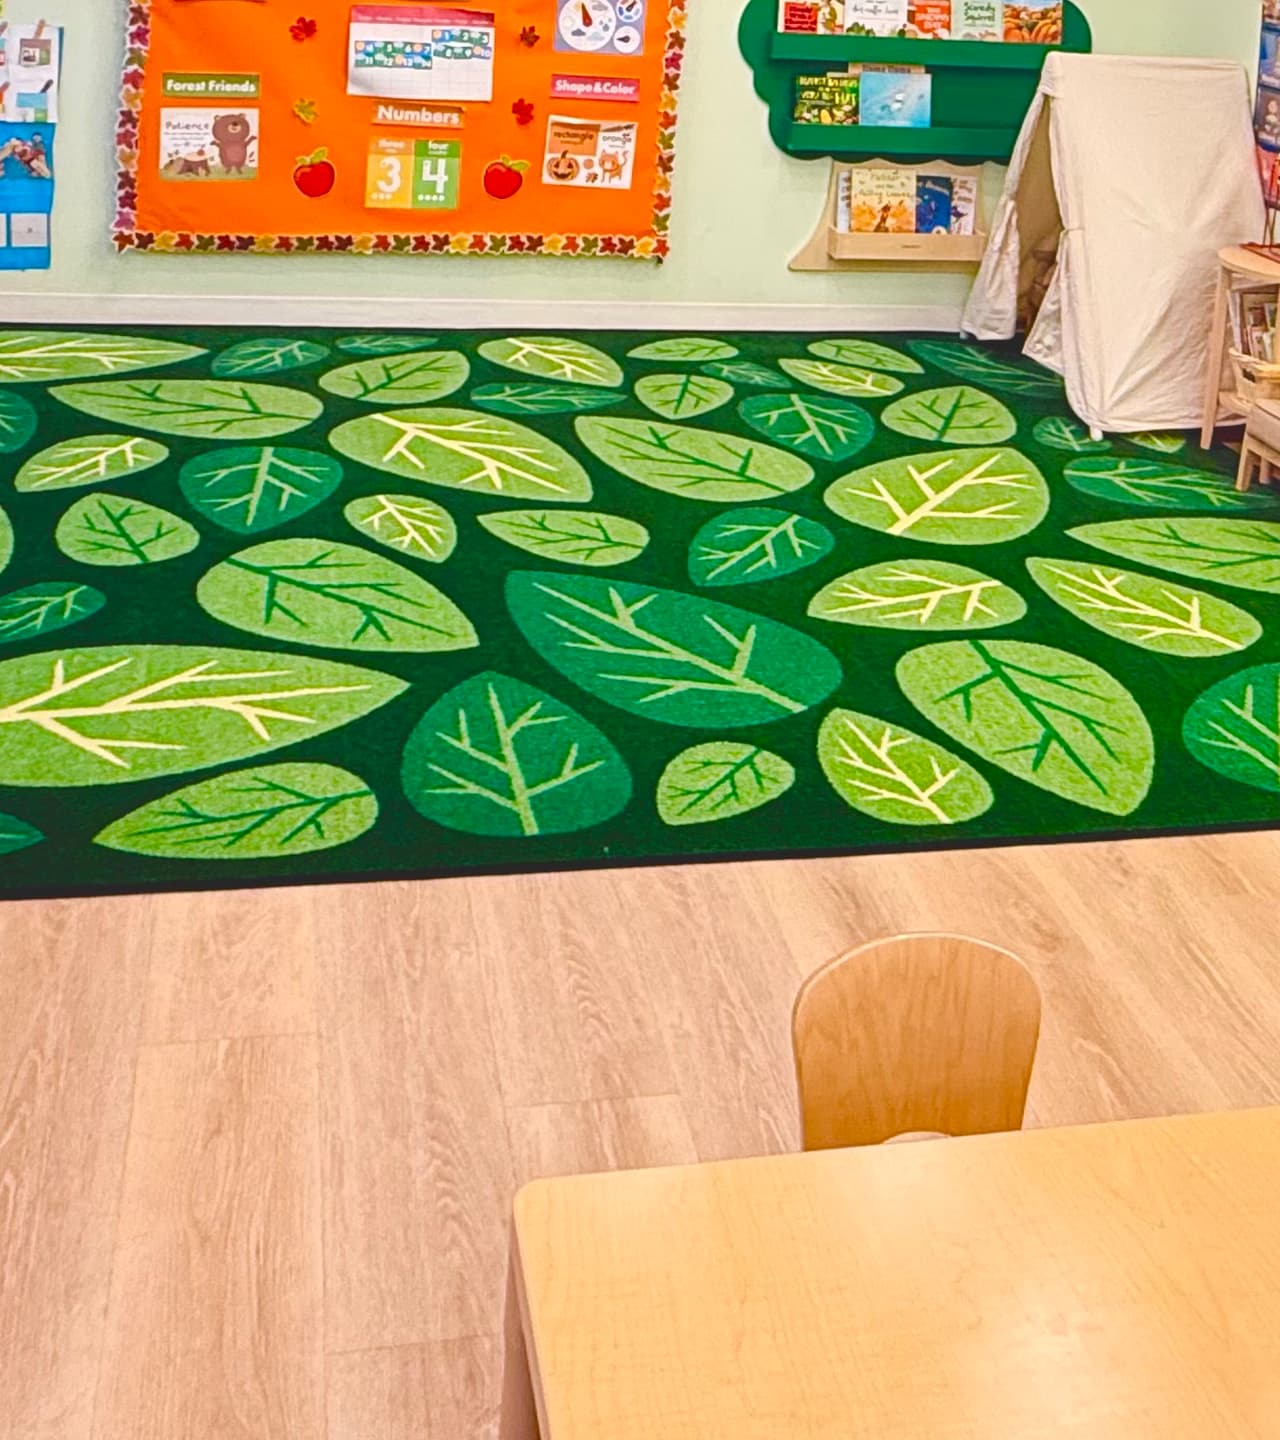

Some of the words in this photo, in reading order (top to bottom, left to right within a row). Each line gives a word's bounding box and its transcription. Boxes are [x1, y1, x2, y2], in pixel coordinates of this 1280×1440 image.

[166, 79, 206, 91] Forest
[208, 80, 256, 92] Friends
[377, 105, 460, 124] Numbers
[165, 121, 209, 131] Patience
[553, 131, 594, 141] rectangle
[377, 156, 402, 193] 3
[422, 158, 449, 194] 4
